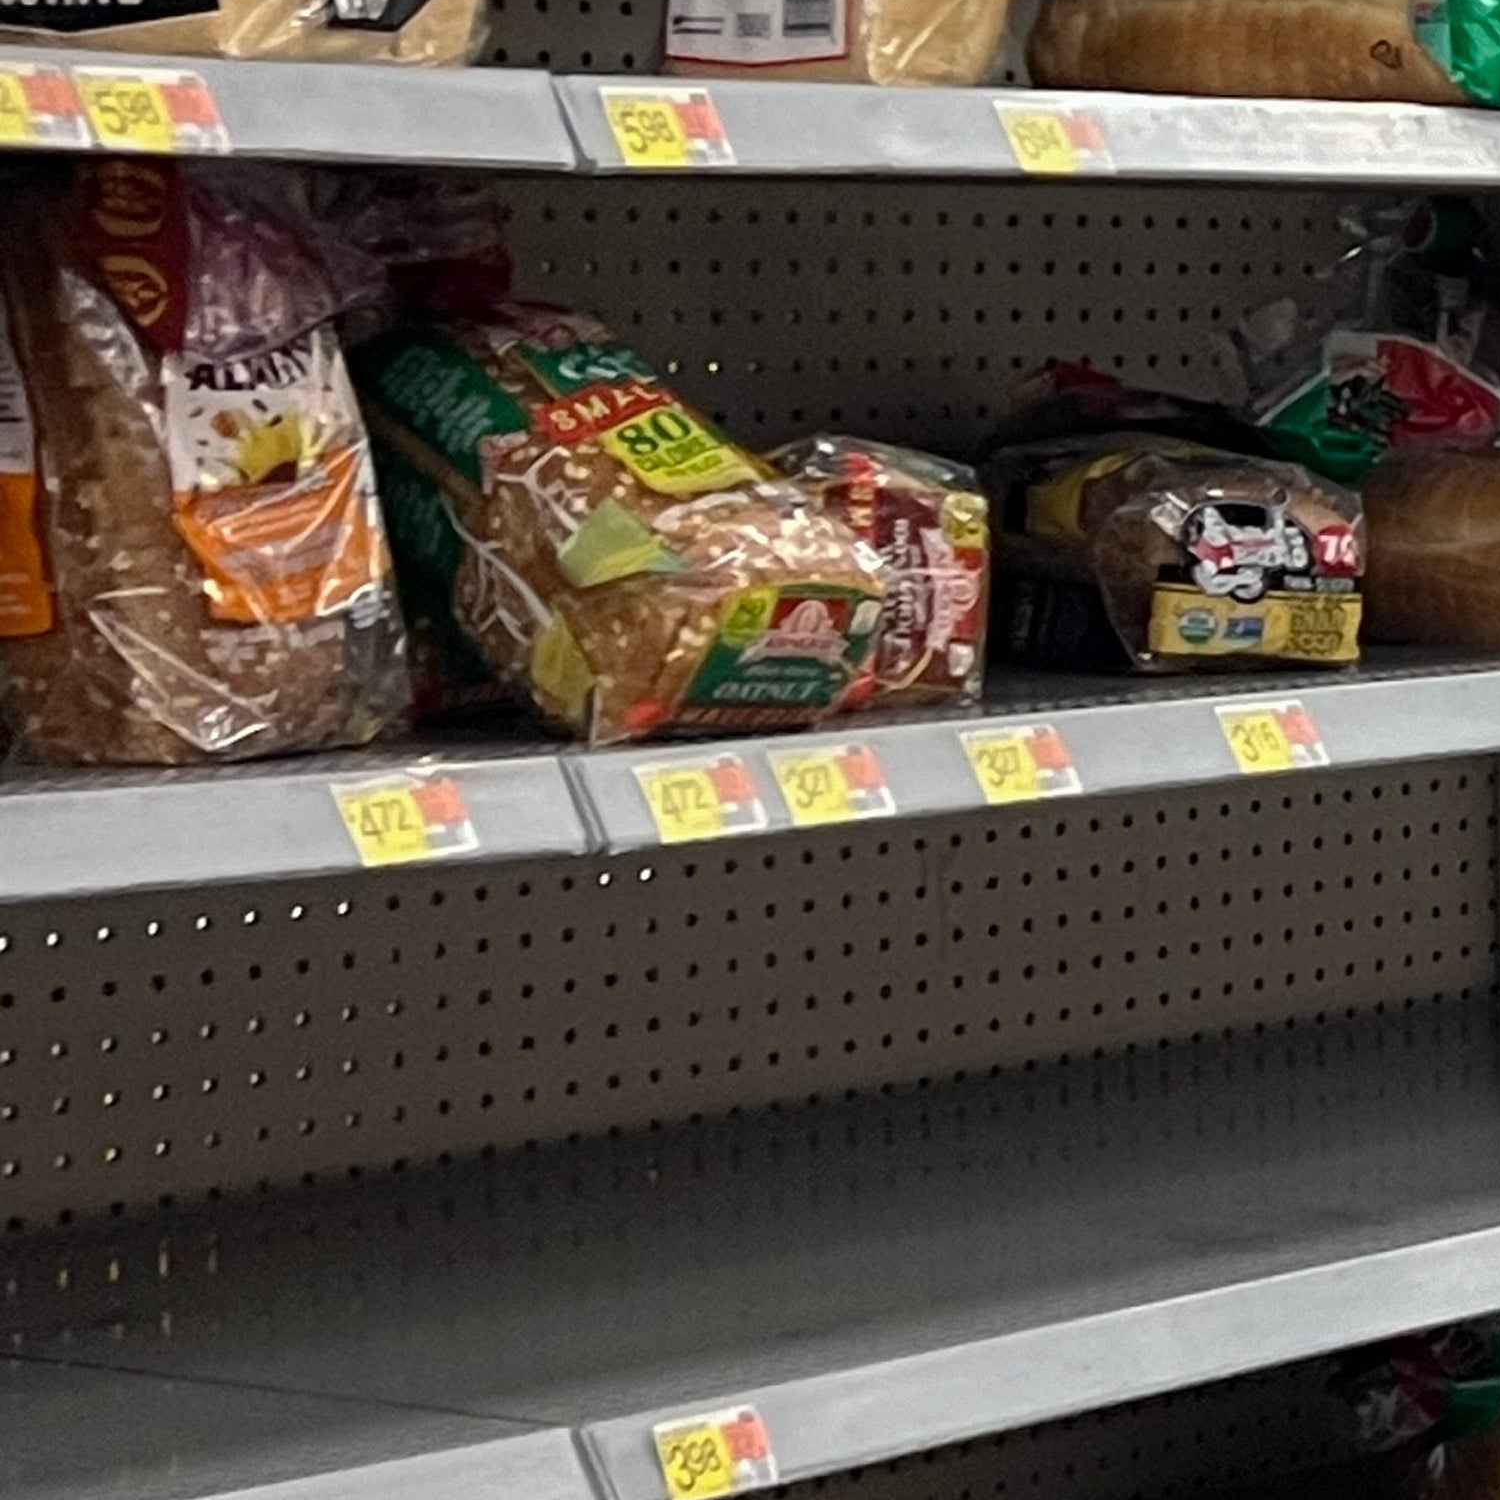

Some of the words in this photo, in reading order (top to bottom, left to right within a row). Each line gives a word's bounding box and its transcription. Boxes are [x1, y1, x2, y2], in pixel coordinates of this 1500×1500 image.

[619, 109, 676, 154] 598
[617, 411, 691, 455] 80
[361, 798, 412, 842] 472
[661, 780, 710, 825] 472
